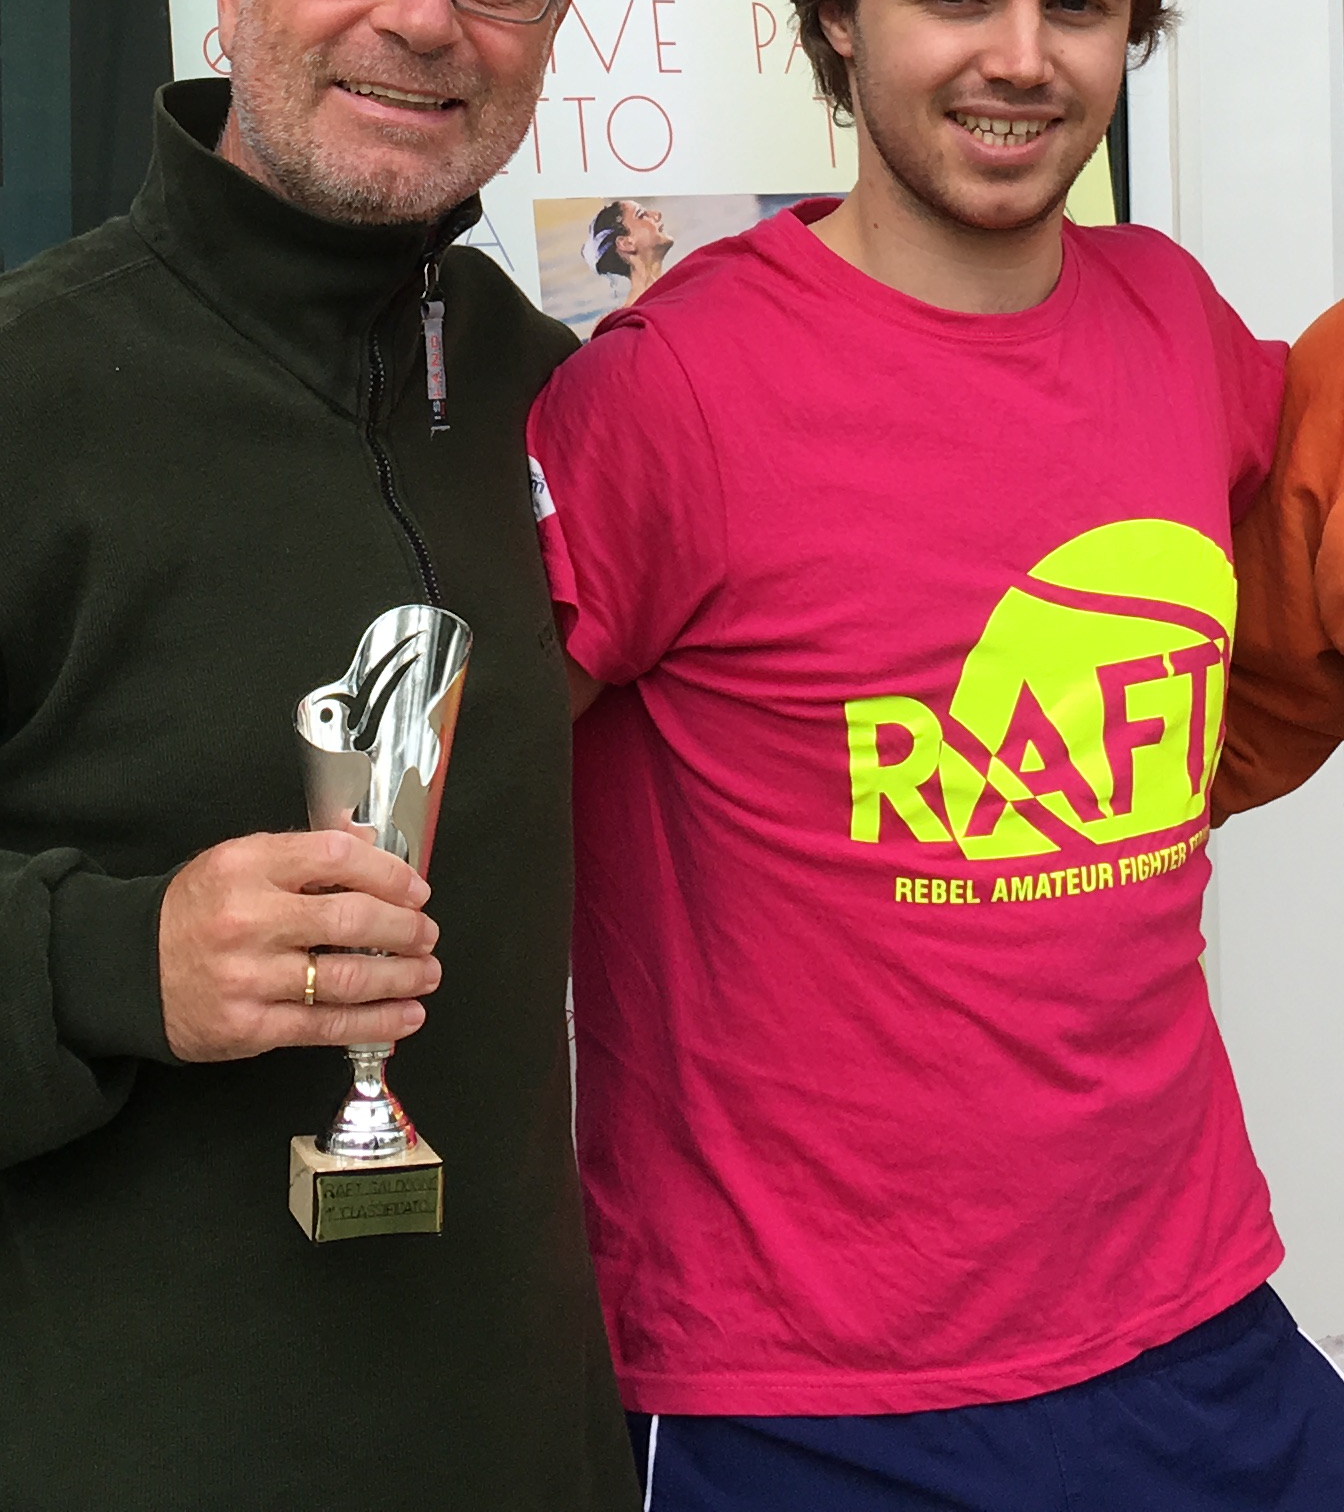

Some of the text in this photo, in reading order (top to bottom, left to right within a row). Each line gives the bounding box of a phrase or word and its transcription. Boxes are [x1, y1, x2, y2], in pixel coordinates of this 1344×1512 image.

[895, 876, 981, 905] REBEL
[990, 862, 1114, 903] AMATEUR
[1118, 841, 1187, 887] FIGHTER
